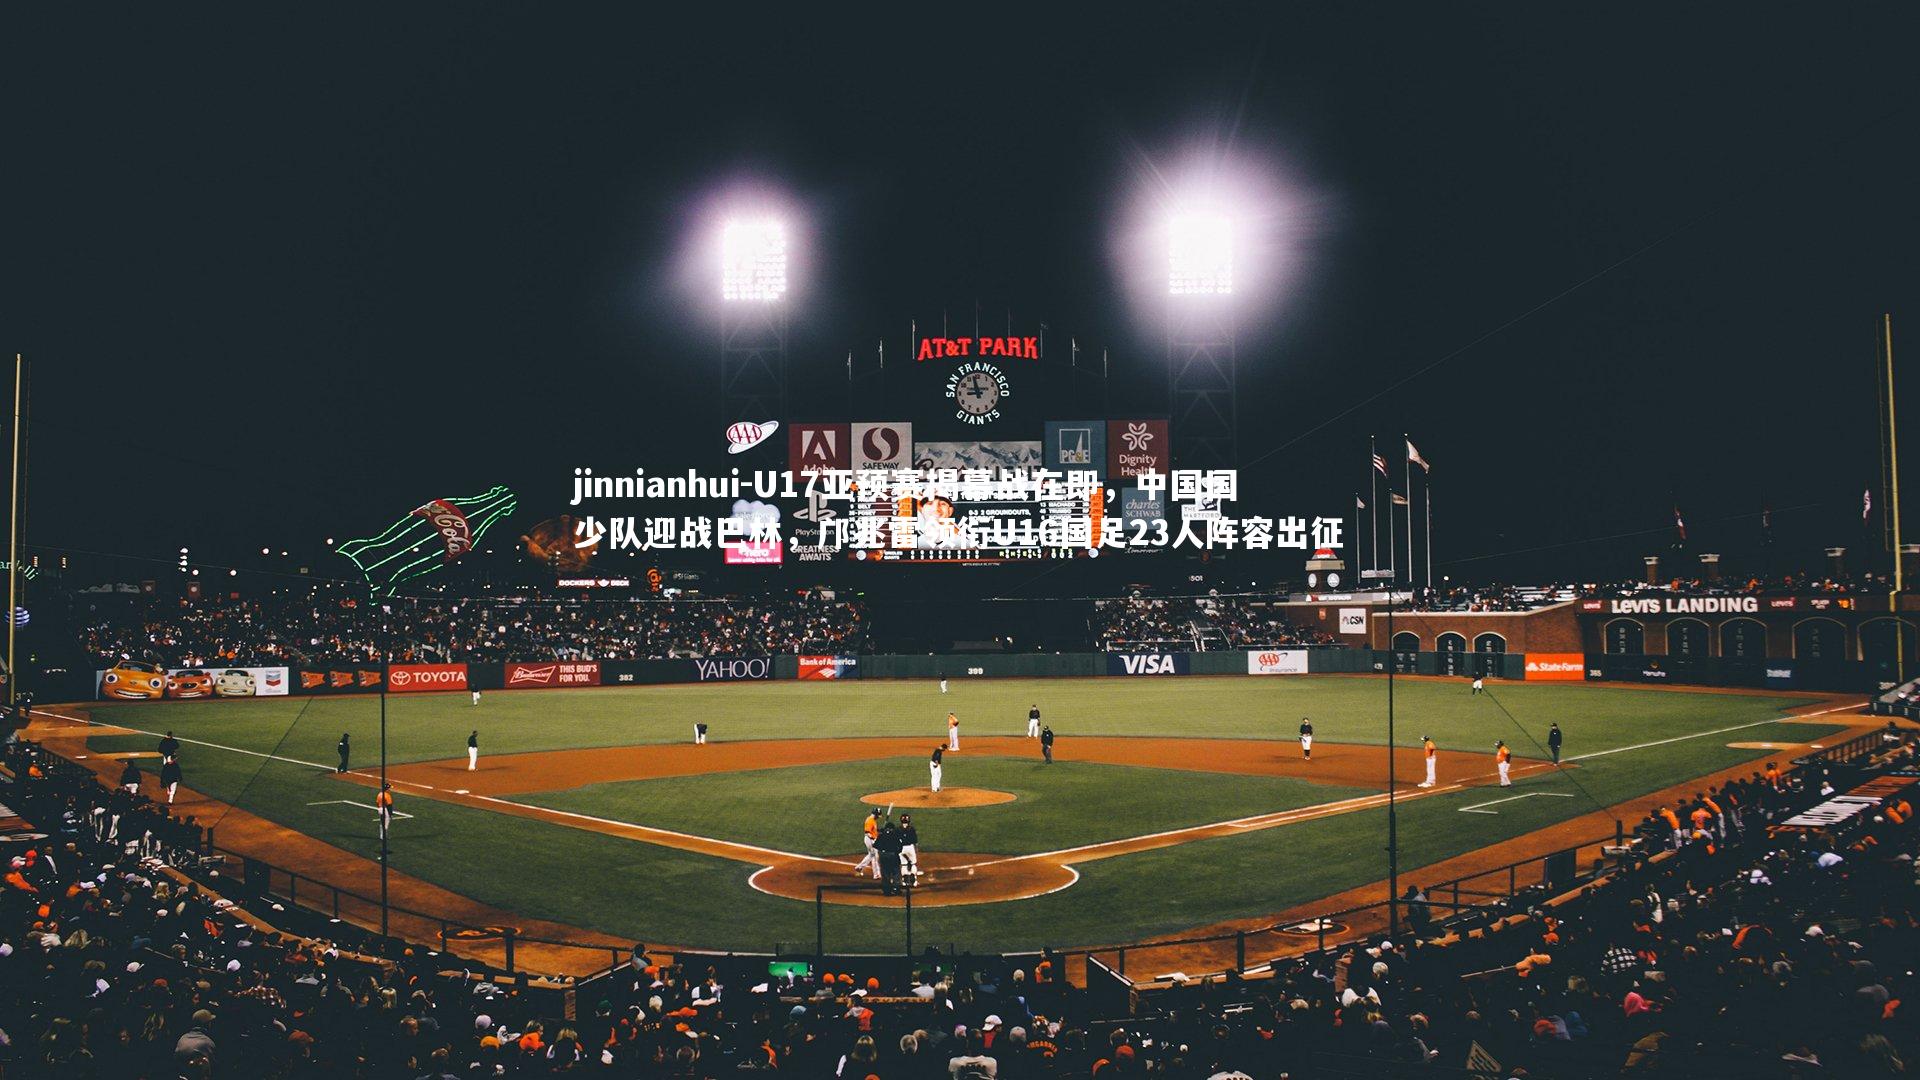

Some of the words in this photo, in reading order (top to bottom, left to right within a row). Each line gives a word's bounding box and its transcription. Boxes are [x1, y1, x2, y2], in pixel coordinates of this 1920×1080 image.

[918, 337, 972, 361] AT&T
[979, 336, 1039, 360] PARK
[945, 373, 960, 398] SAN
[957, 361, 1010, 397] FRANCISCO
[956, 409, 1001, 425] GIANTS
[731, 424, 761, 444] AAA
[1061, 450, 1090, 463] PG&E
[1119, 454, 1157, 466] Dignity
[862, 462, 900, 470] SAFEWAY
[1121, 467, 1155, 477] Healt
[1125, 499, 1160, 510] charles
[1125, 510, 1161, 518] SCHWAB
[799, 553, 832, 561] AWAITS
[1666, 597, 1759, 613] LANDING
[1349, 616, 1364, 625] CSN
[800, 658, 819, 666] Bank
[819, 658, 826, 666] of
[826, 658, 856, 666] America
[1119, 654, 1176, 674] VISA
[1259, 653, 1280, 666] AAA
[559, 665, 576, 674] THIS
[577, 664, 598, 673] BUD'S
[695, 658, 771, 681] YAHOO!
[413, 671, 467, 683] TOYOTA
[559, 674, 574, 683] FOR
[575, 673, 590, 683] YOU.
